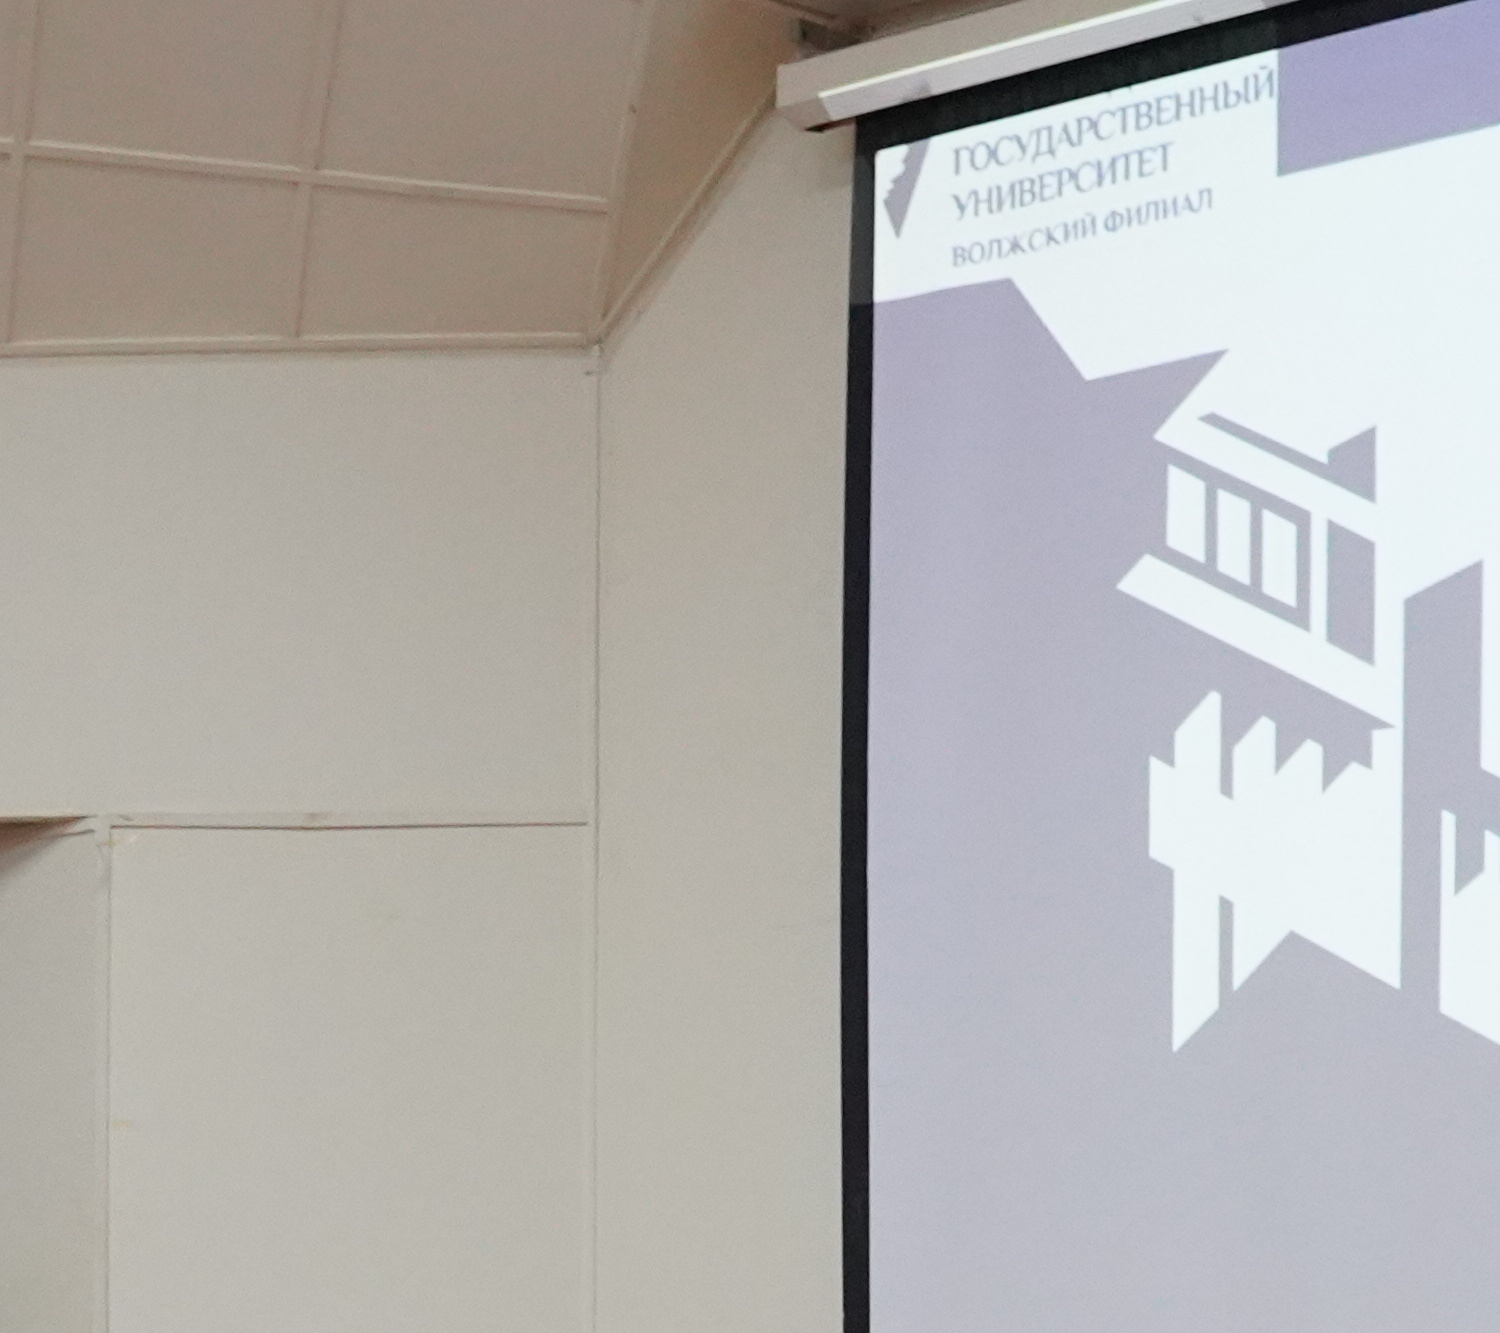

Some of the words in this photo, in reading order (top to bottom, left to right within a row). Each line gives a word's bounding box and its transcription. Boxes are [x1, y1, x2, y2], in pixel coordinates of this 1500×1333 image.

[952, 65, 1276, 176] ГОСУДАРСТВЕННЫЙ
[951, 141, 1175, 221] УНИВЕРСИТЕТ
[951, 212, 1098, 268] ВОЛЖСКИЙ
[1103, 187, 1214, 234] ФИЛИАЛ
